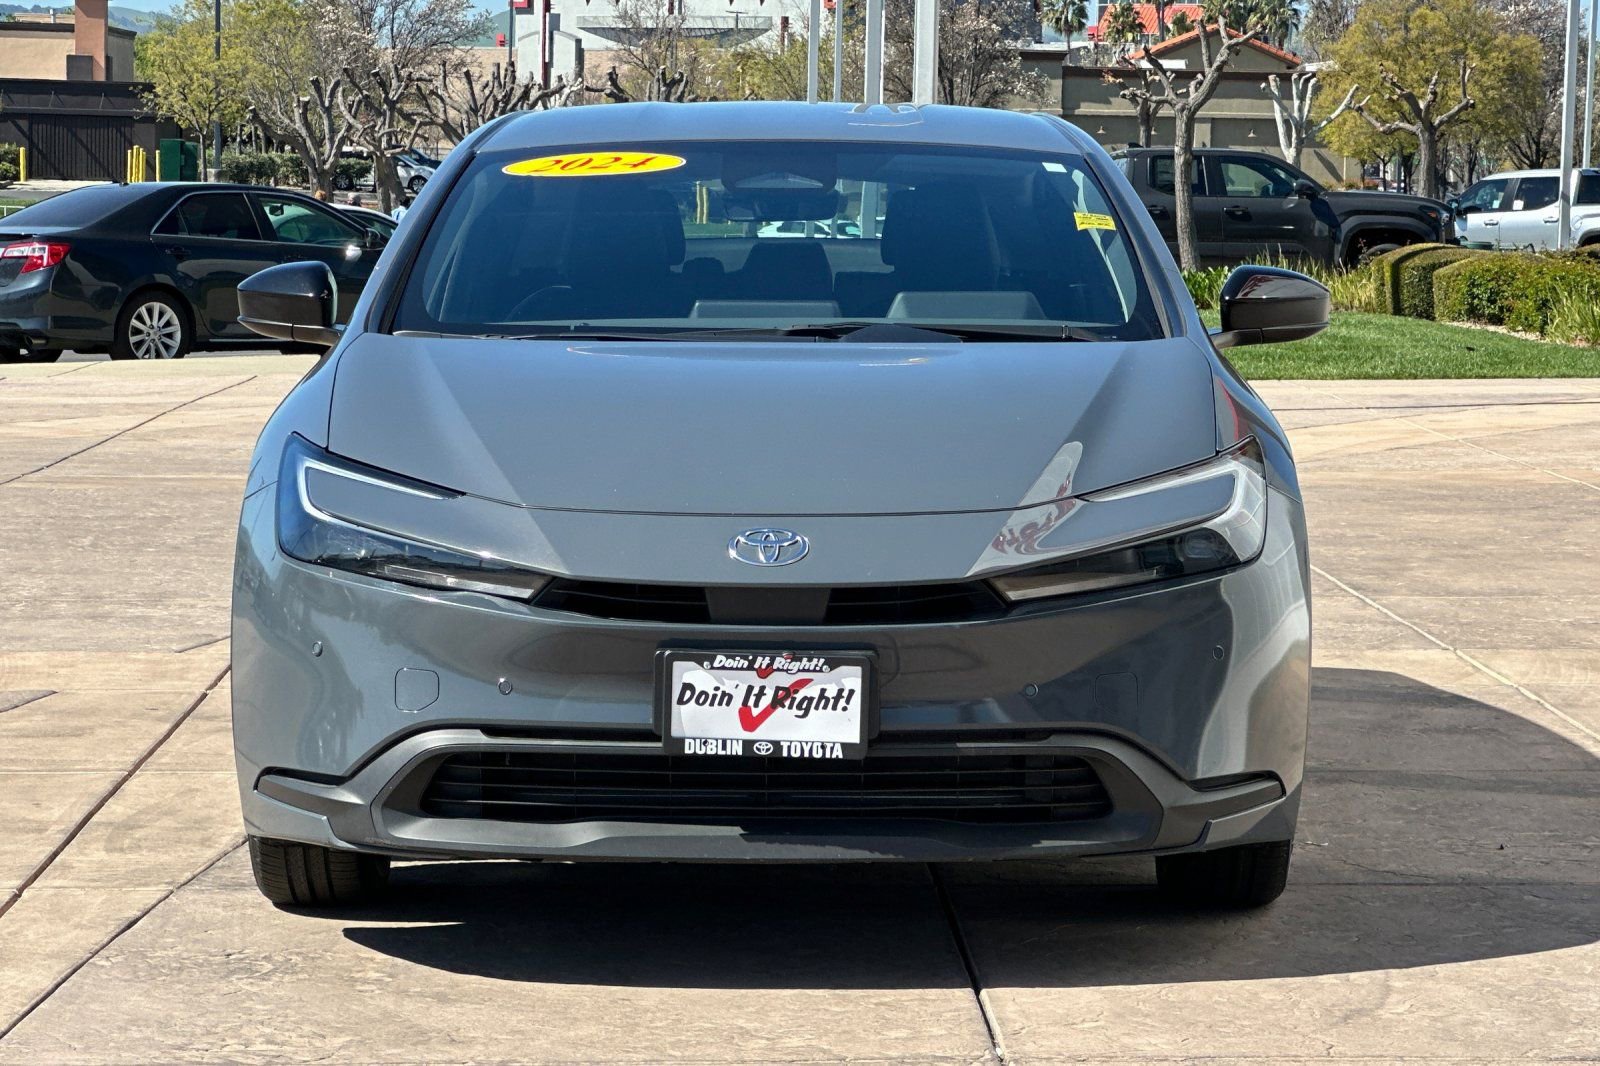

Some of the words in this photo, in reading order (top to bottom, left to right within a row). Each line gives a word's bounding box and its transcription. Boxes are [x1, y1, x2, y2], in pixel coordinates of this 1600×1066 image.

[529, 156, 658, 173] 2024
[713, 655, 752, 669] Doin'
[754, 656, 770, 670] It
[772, 657, 825, 674] Right!
[676, 682, 739, 707] Doin'
[741, 684, 767, 709] It
[770, 685, 855, 719] Right!
[684, 738, 743, 756] DUBLIN
[780, 741, 843, 758] TOYOTA
